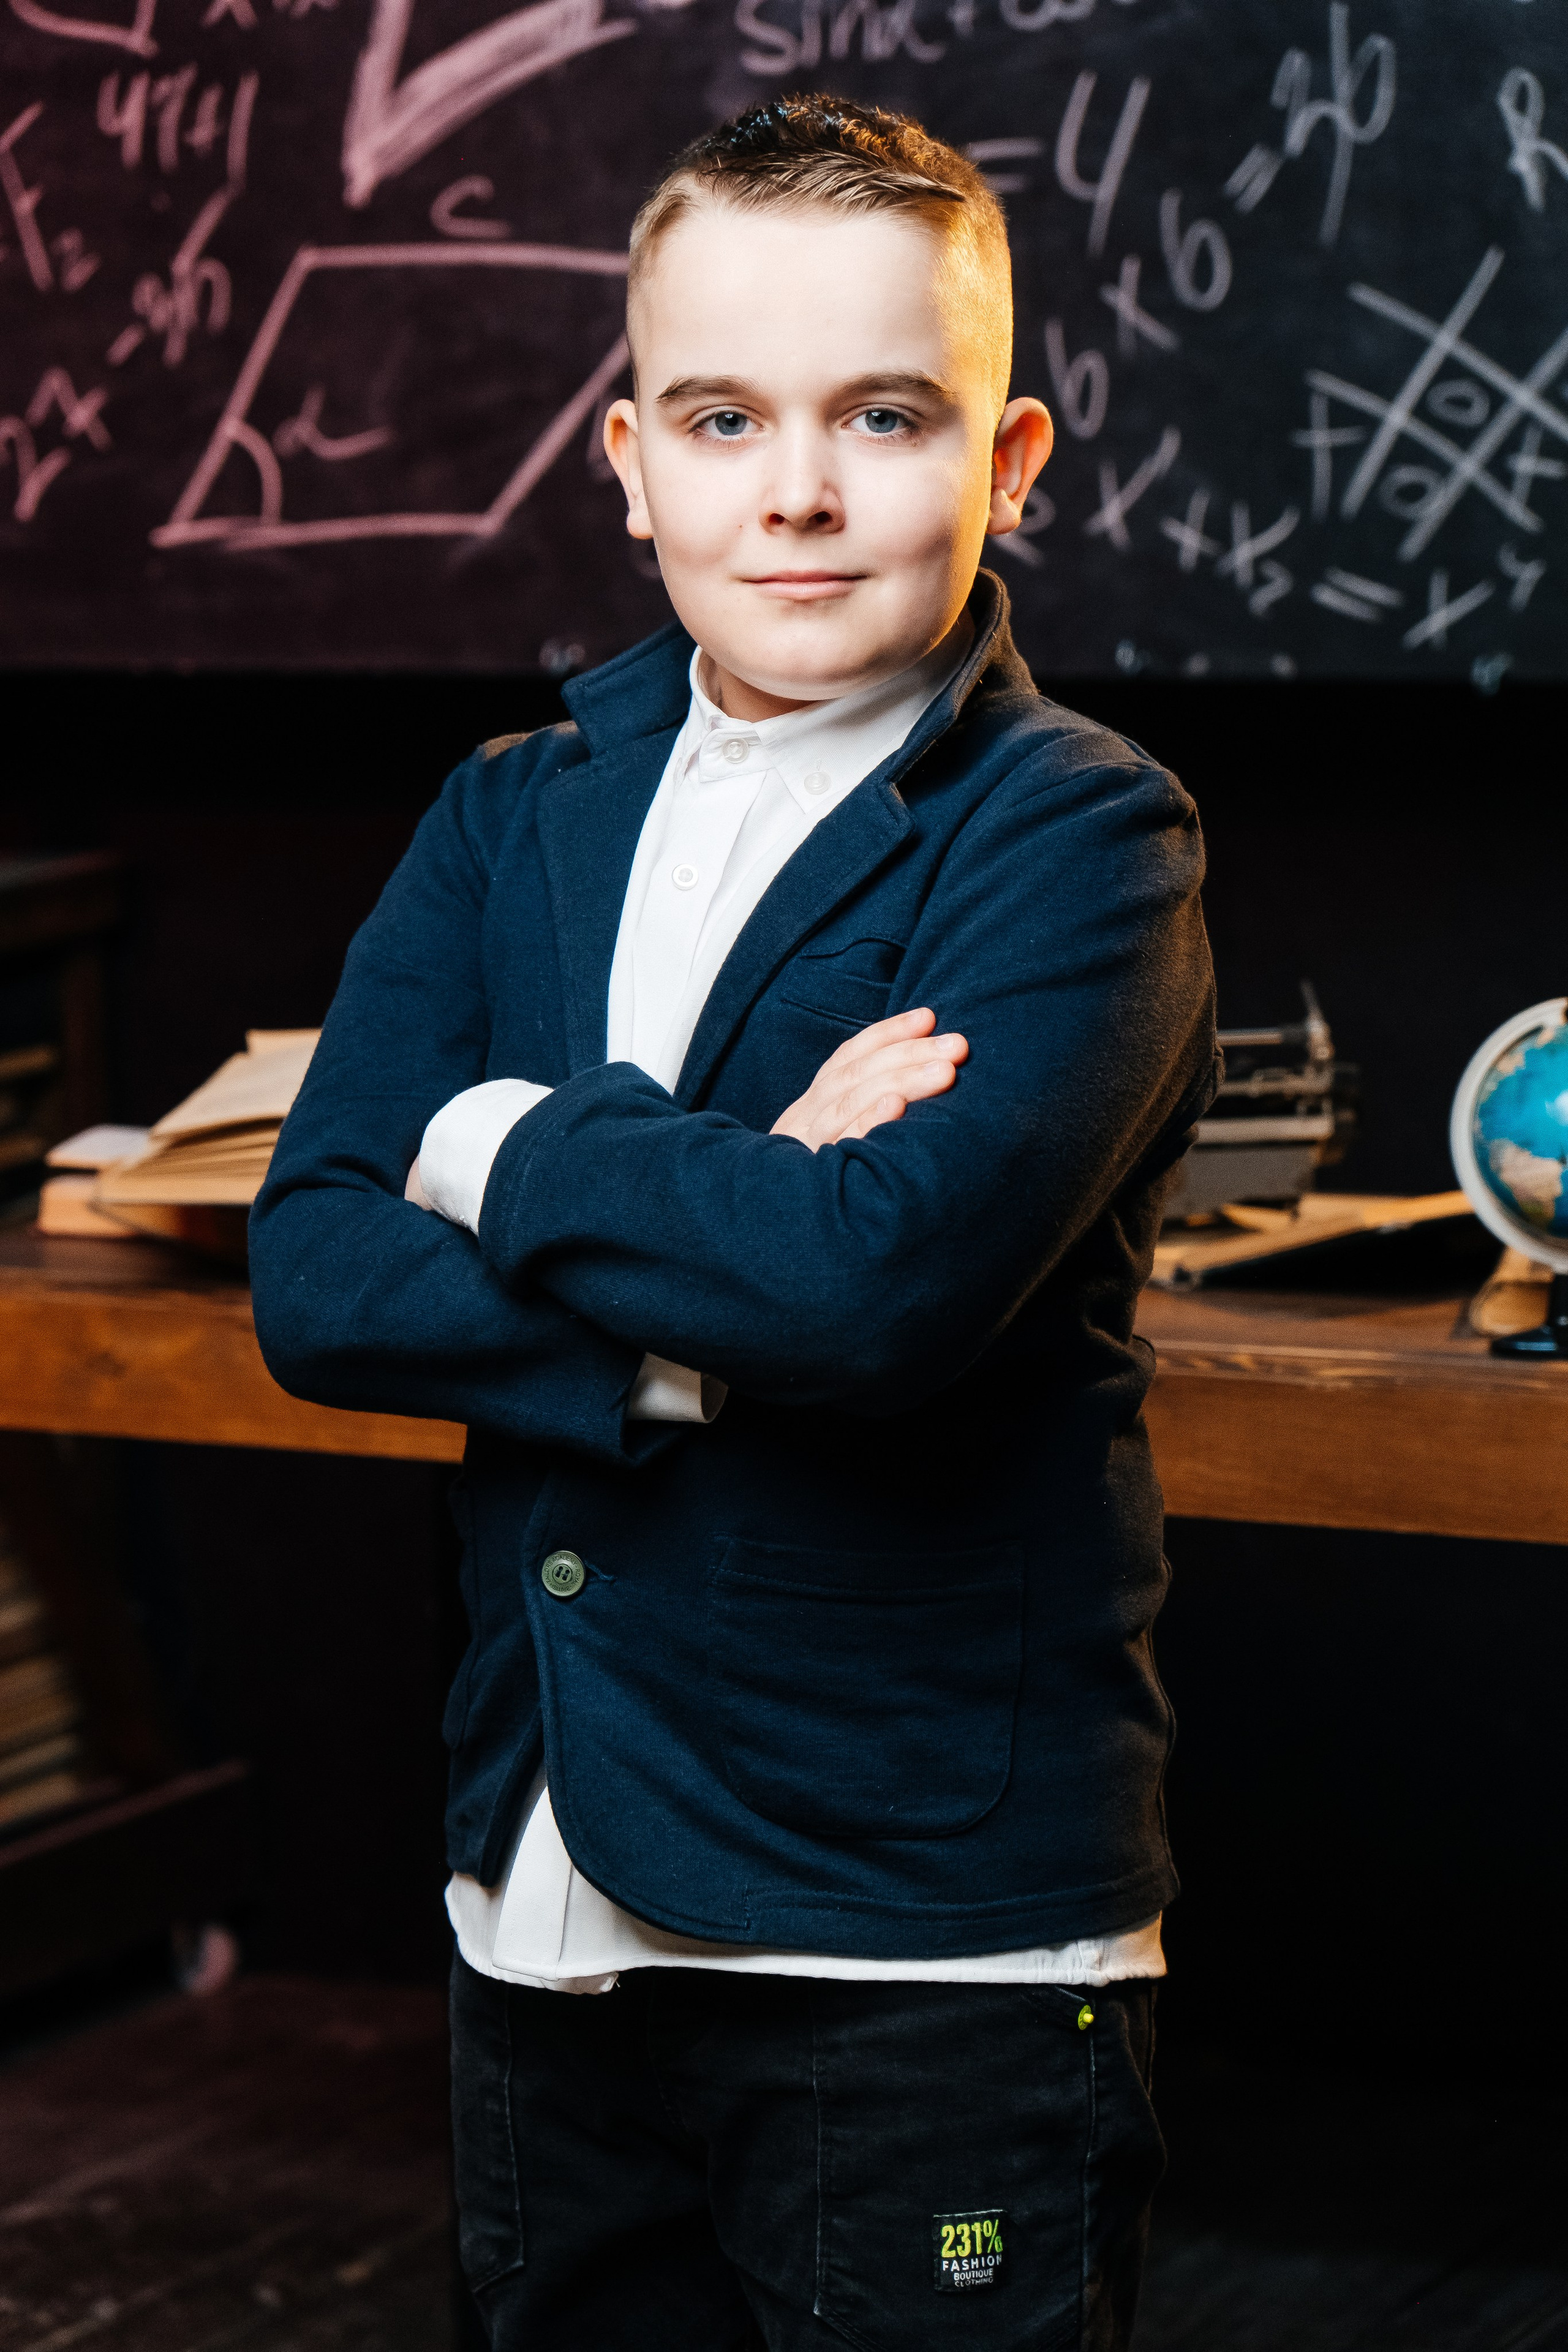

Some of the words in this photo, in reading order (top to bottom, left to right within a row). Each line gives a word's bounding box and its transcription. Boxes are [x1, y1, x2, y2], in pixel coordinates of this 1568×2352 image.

[941, 2219, 1003, 2258] 231%
[942, 2255, 1002, 2272] FASHION
[954, 2268, 993, 2280] BOUTIQUE
[954, 2276, 993, 2287] CLOTHING
